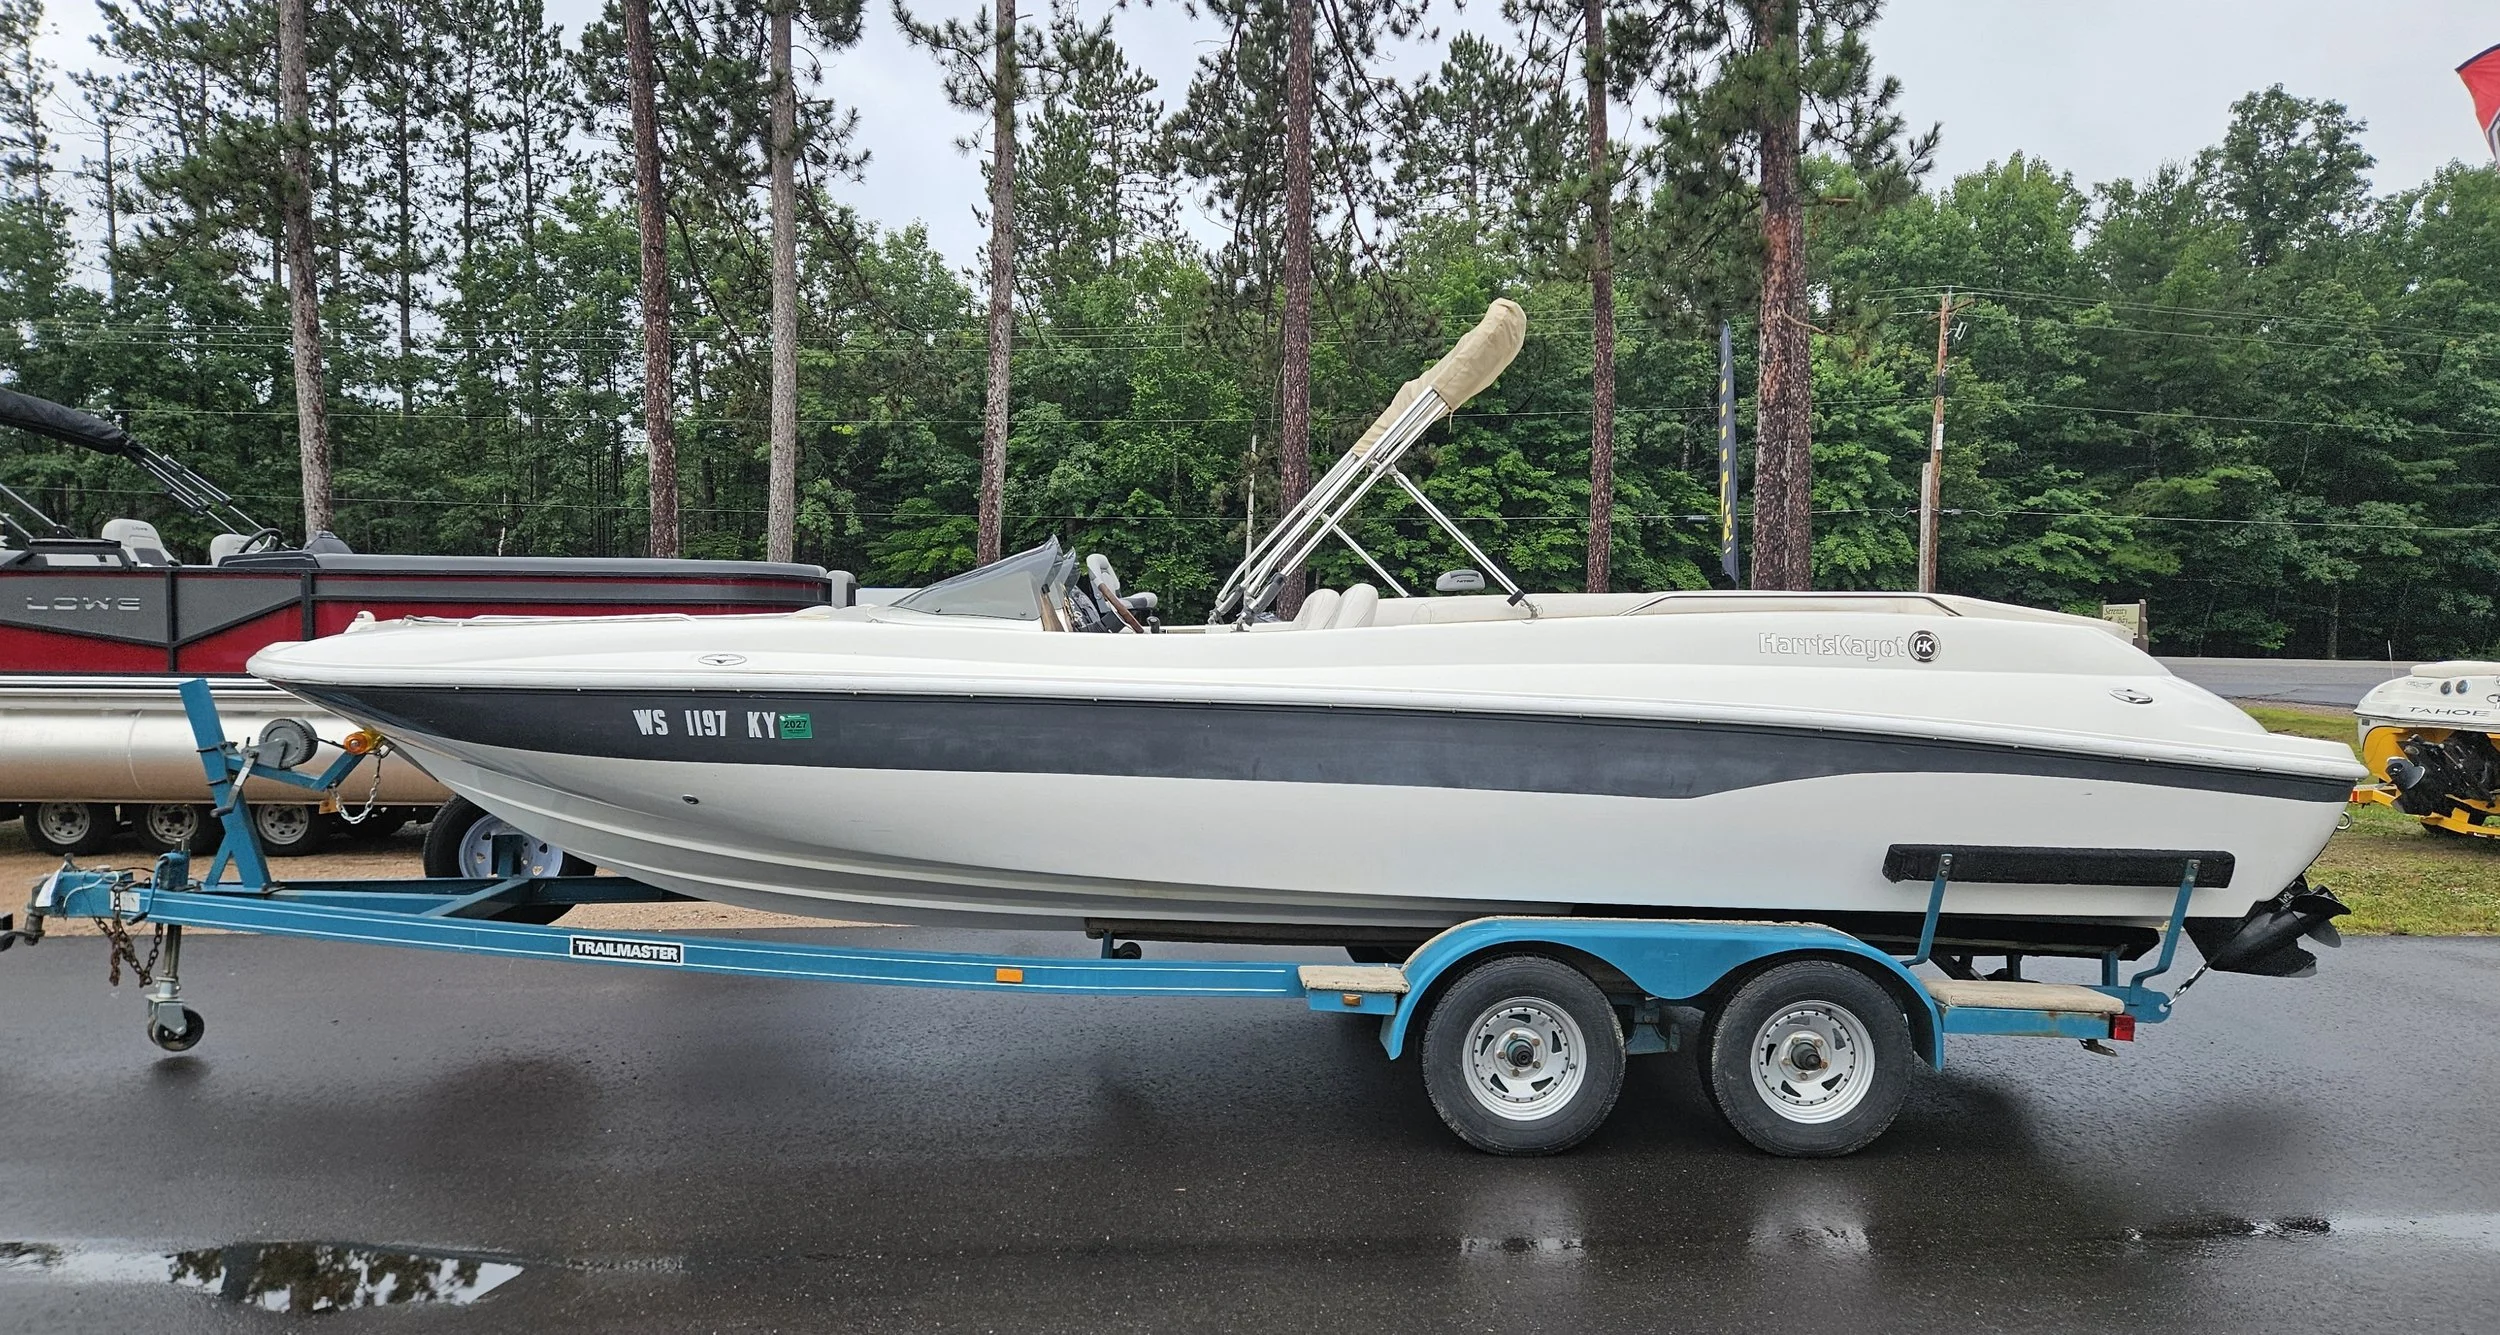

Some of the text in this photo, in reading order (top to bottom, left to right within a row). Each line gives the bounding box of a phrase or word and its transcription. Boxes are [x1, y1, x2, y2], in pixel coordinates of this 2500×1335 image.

[26, 597, 141, 611] LOWE
[1759, 633, 1905, 662] HarrisKayot
[1916, 640, 1933, 653] HK
[2408, 706, 2490, 717] TAHOE
[633, 709, 776, 739] WS 1197 KY
[784, 720, 807, 729] 2027
[576, 940, 678, 960] TRAILMASTER
